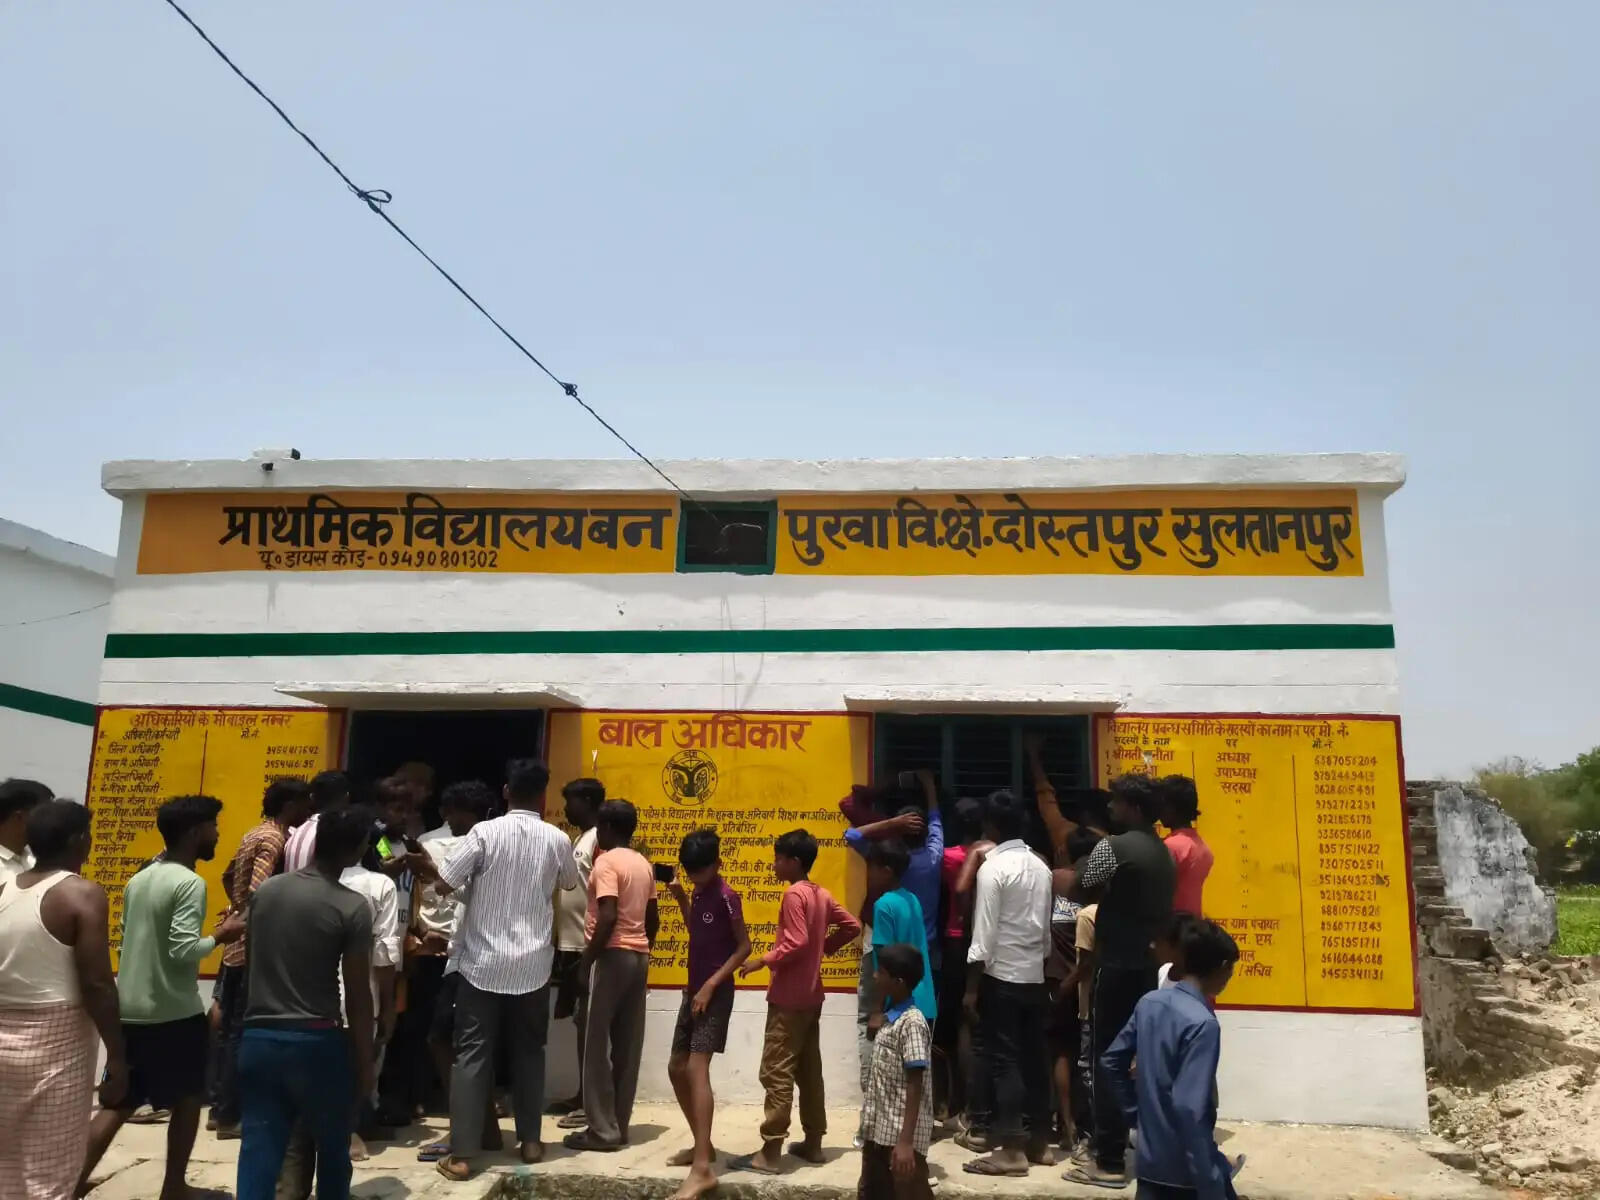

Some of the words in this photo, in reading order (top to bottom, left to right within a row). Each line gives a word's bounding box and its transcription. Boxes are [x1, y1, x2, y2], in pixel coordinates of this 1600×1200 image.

[219, 494, 398, 548] प्राथमिक
[400, 492, 588, 551] विद्यालय
[784, 508, 892, 566] पुरवा
[379, 551, 498, 569] 09490801302
[598, 719, 669, 750] बाल
[672, 713, 812, 753] अधिकार
[747, 888, 782, 902] शौचालय
